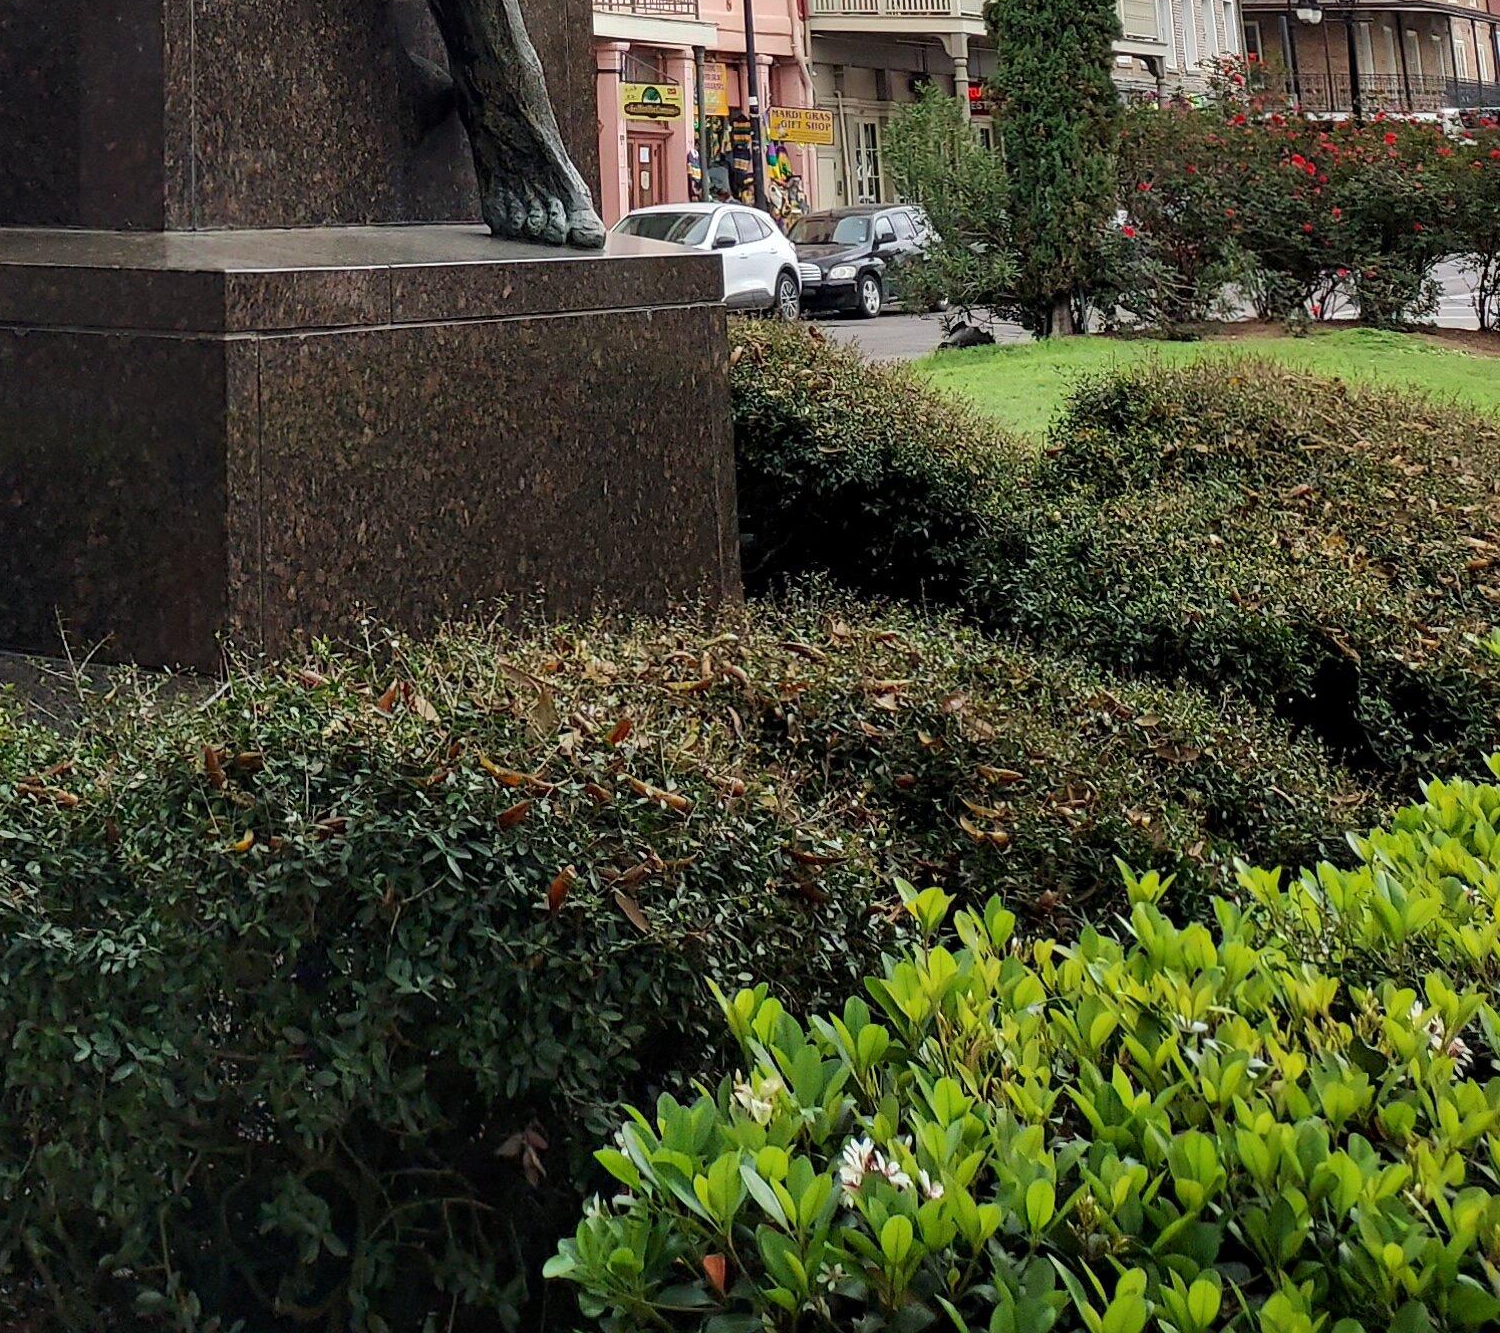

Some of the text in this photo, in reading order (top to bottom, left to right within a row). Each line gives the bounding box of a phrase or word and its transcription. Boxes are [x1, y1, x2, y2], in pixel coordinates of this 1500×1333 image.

[772, 109, 831, 121] MARDI GRAS
[780, 119, 831, 131] GIFT SHOP
